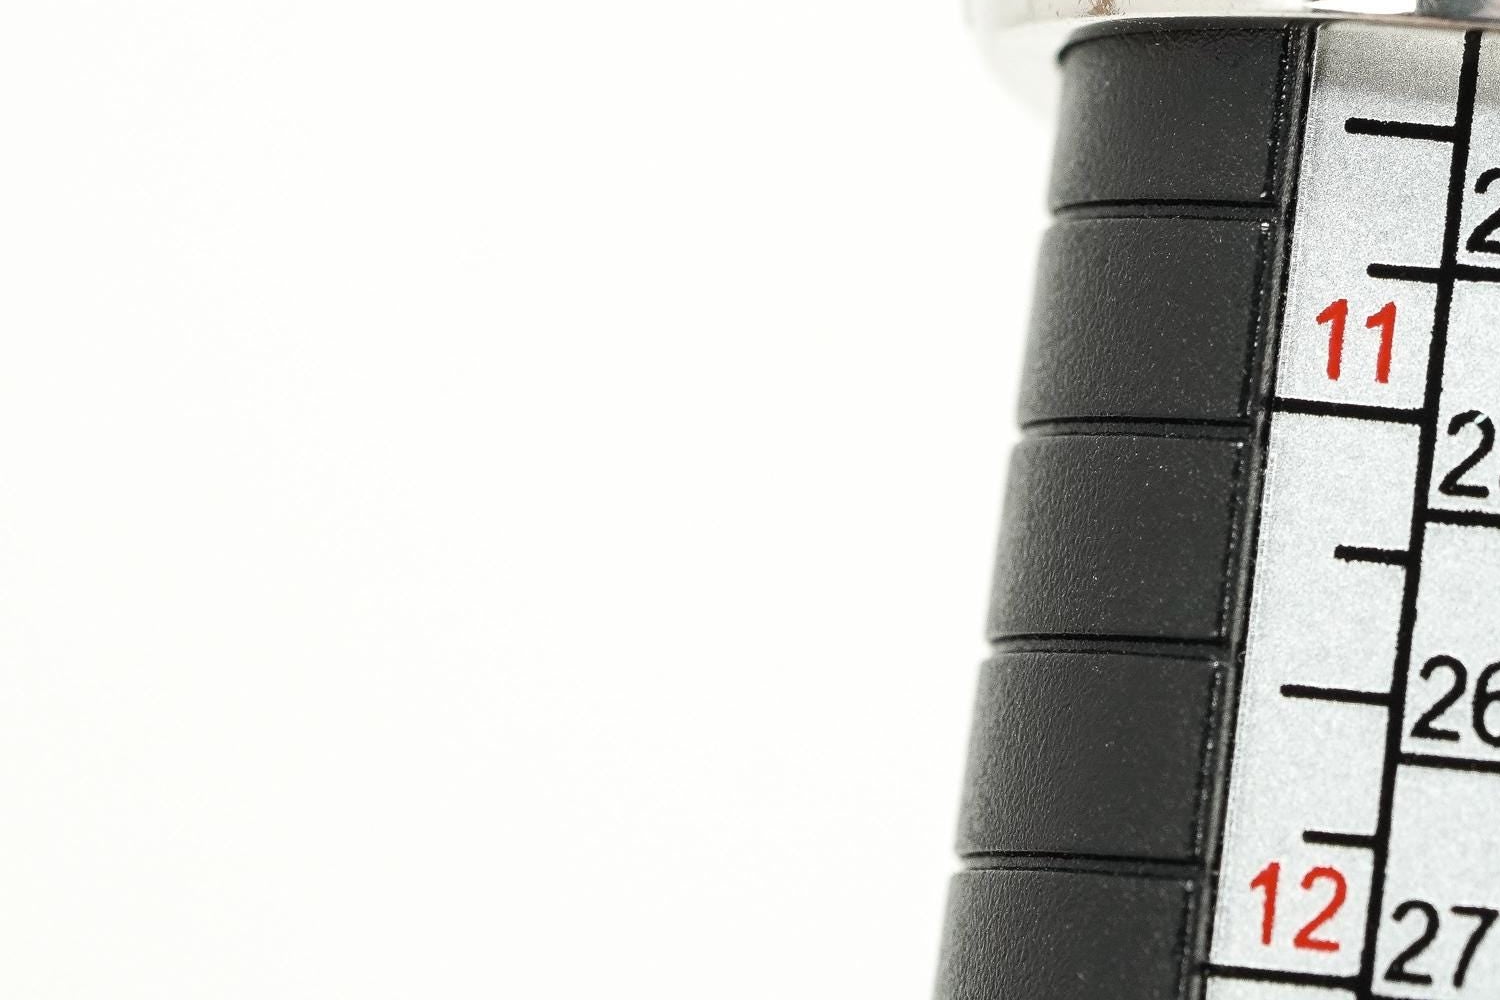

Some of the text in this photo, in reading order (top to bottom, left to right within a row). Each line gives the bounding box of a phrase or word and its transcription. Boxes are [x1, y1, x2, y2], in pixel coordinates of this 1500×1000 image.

[1315, 298, 1397, 384] 11
[1250, 862, 1348, 953] 12
[1383, 899, 1500, 989] 27
